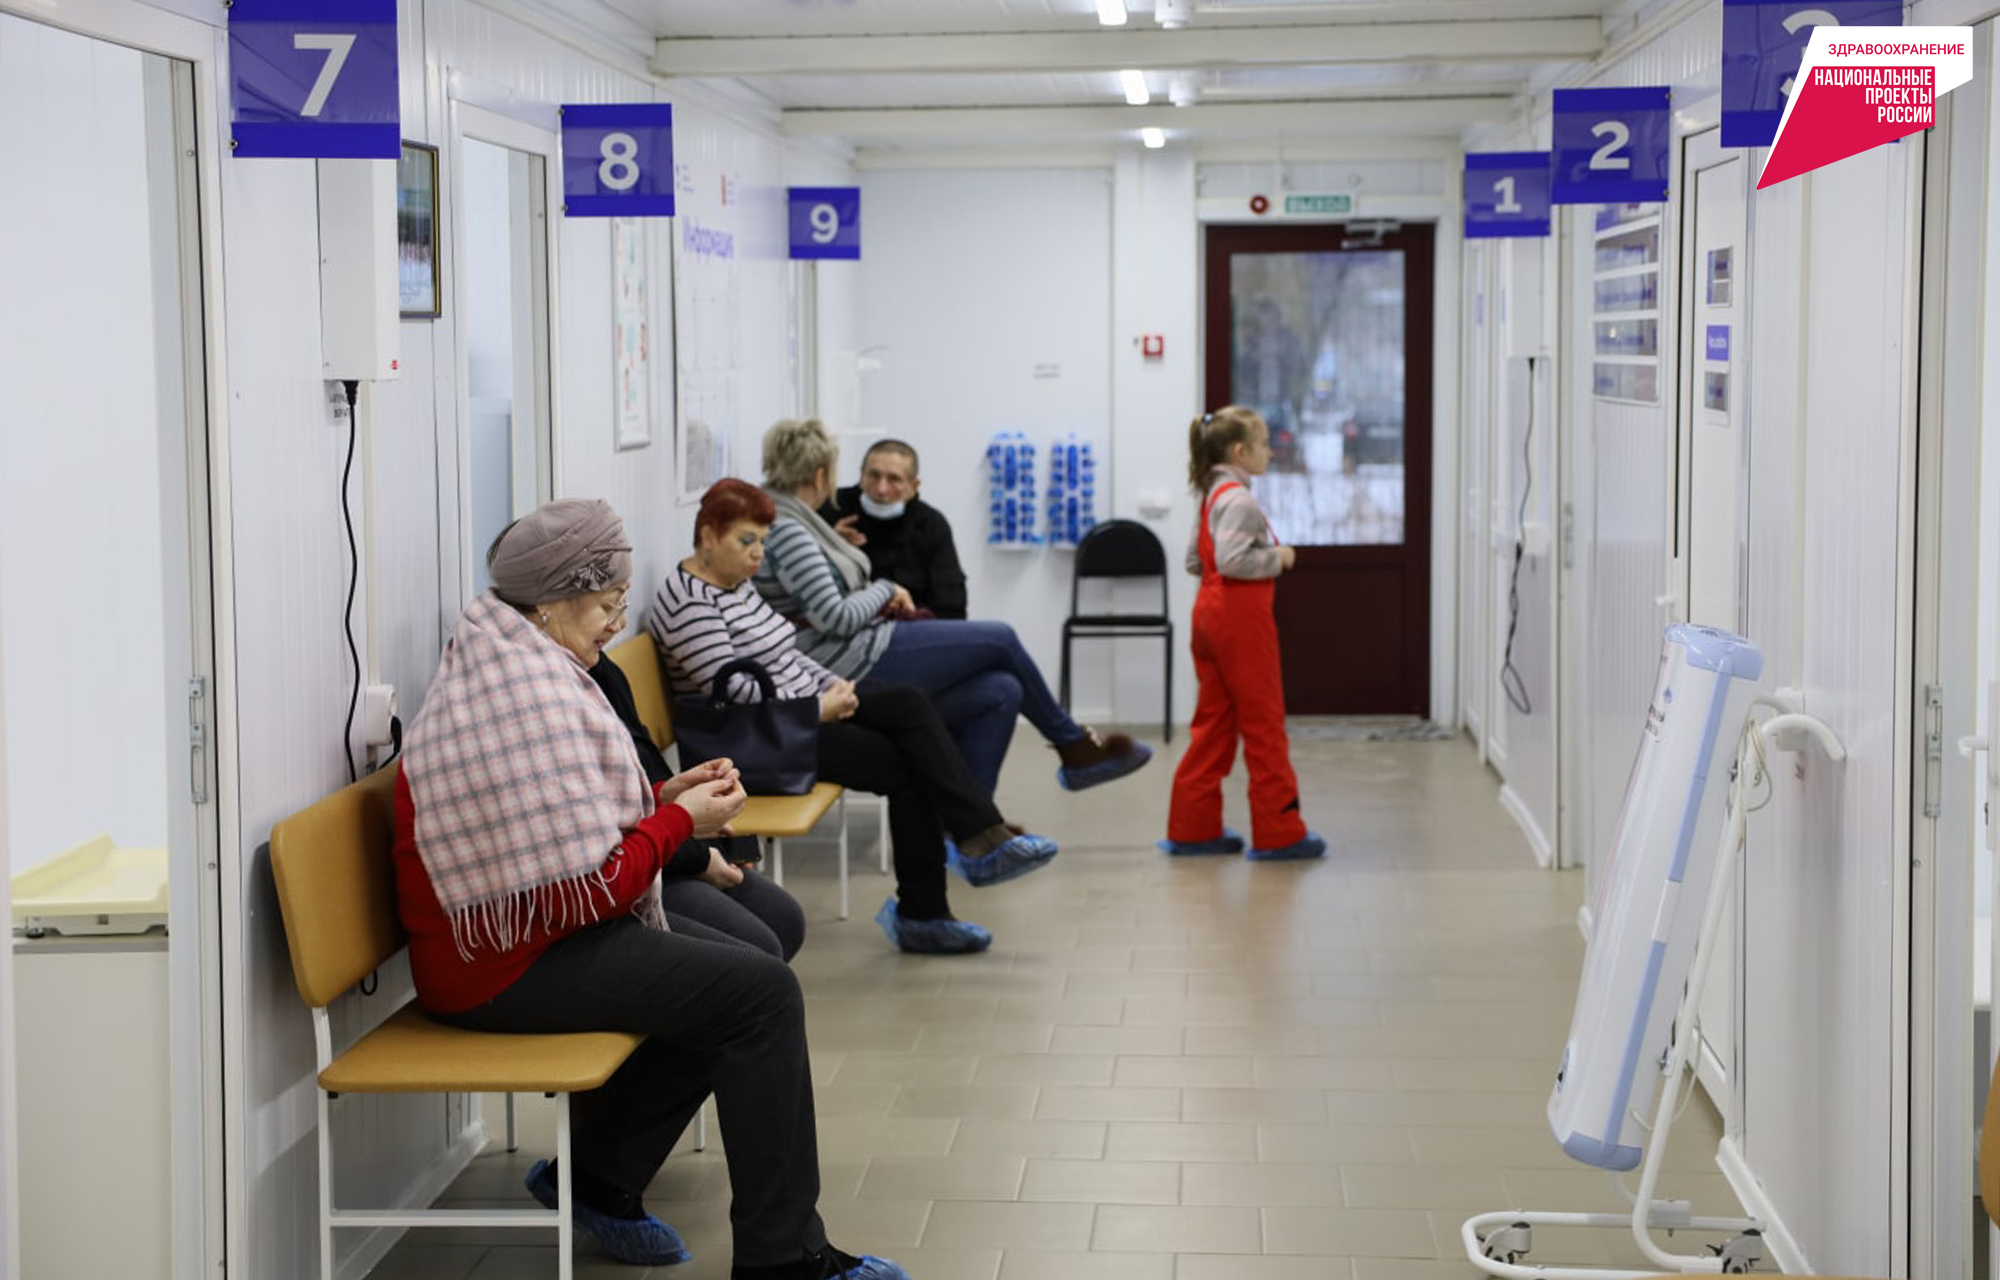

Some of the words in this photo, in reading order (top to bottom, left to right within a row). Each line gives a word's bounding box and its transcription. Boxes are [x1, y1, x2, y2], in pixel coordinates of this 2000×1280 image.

[294, 34, 356, 116] 7
[599, 132, 639, 190] 8
[1590, 121, 1630, 170] 2
[1287, 196, 1349, 212] ВЫХОД
[1494, 177, 1521, 213] 1
[810, 203, 839, 243] 9
